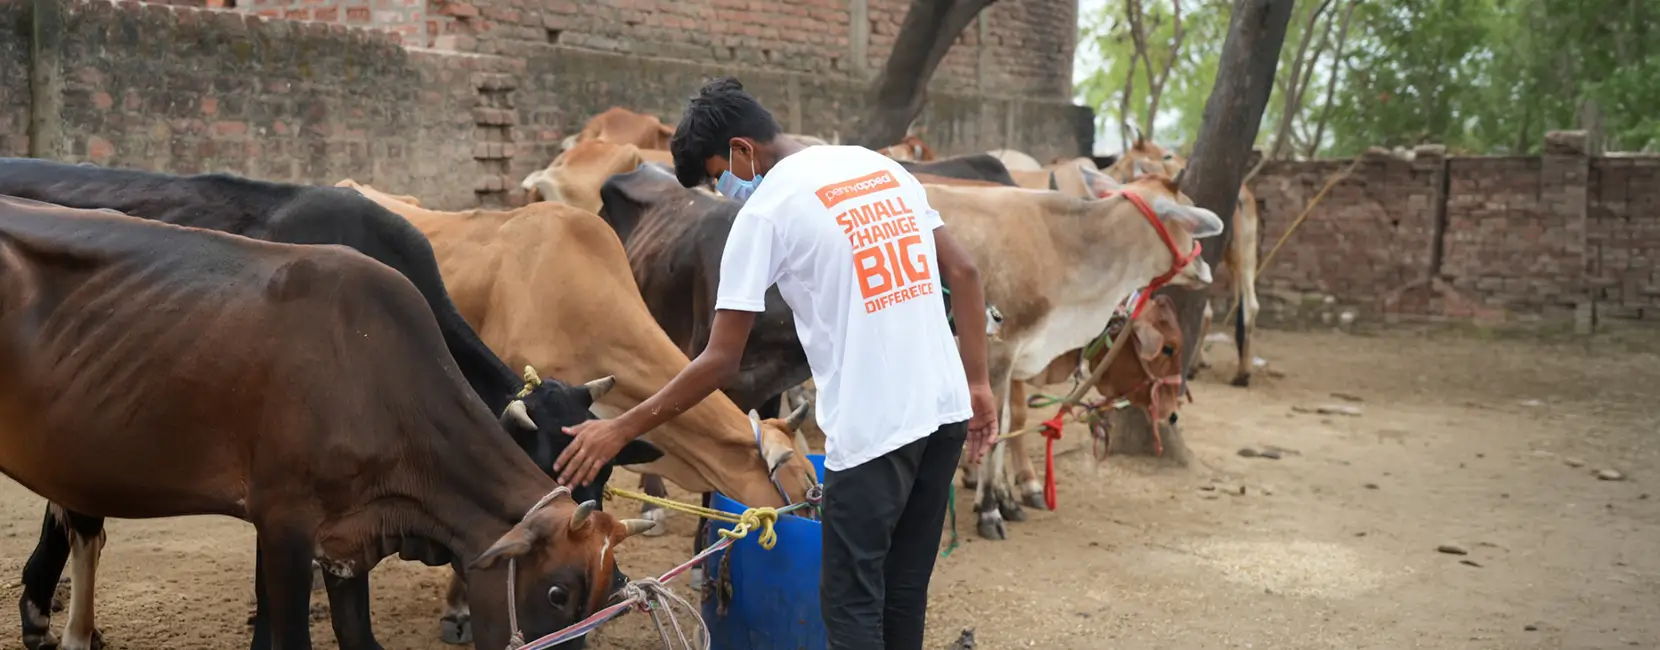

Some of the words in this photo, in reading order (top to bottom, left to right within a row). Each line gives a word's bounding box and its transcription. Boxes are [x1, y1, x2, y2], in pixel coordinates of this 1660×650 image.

[836, 196, 913, 234] SMALL
[848, 216, 920, 250] CHANGE
[853, 235, 931, 299] BIG
